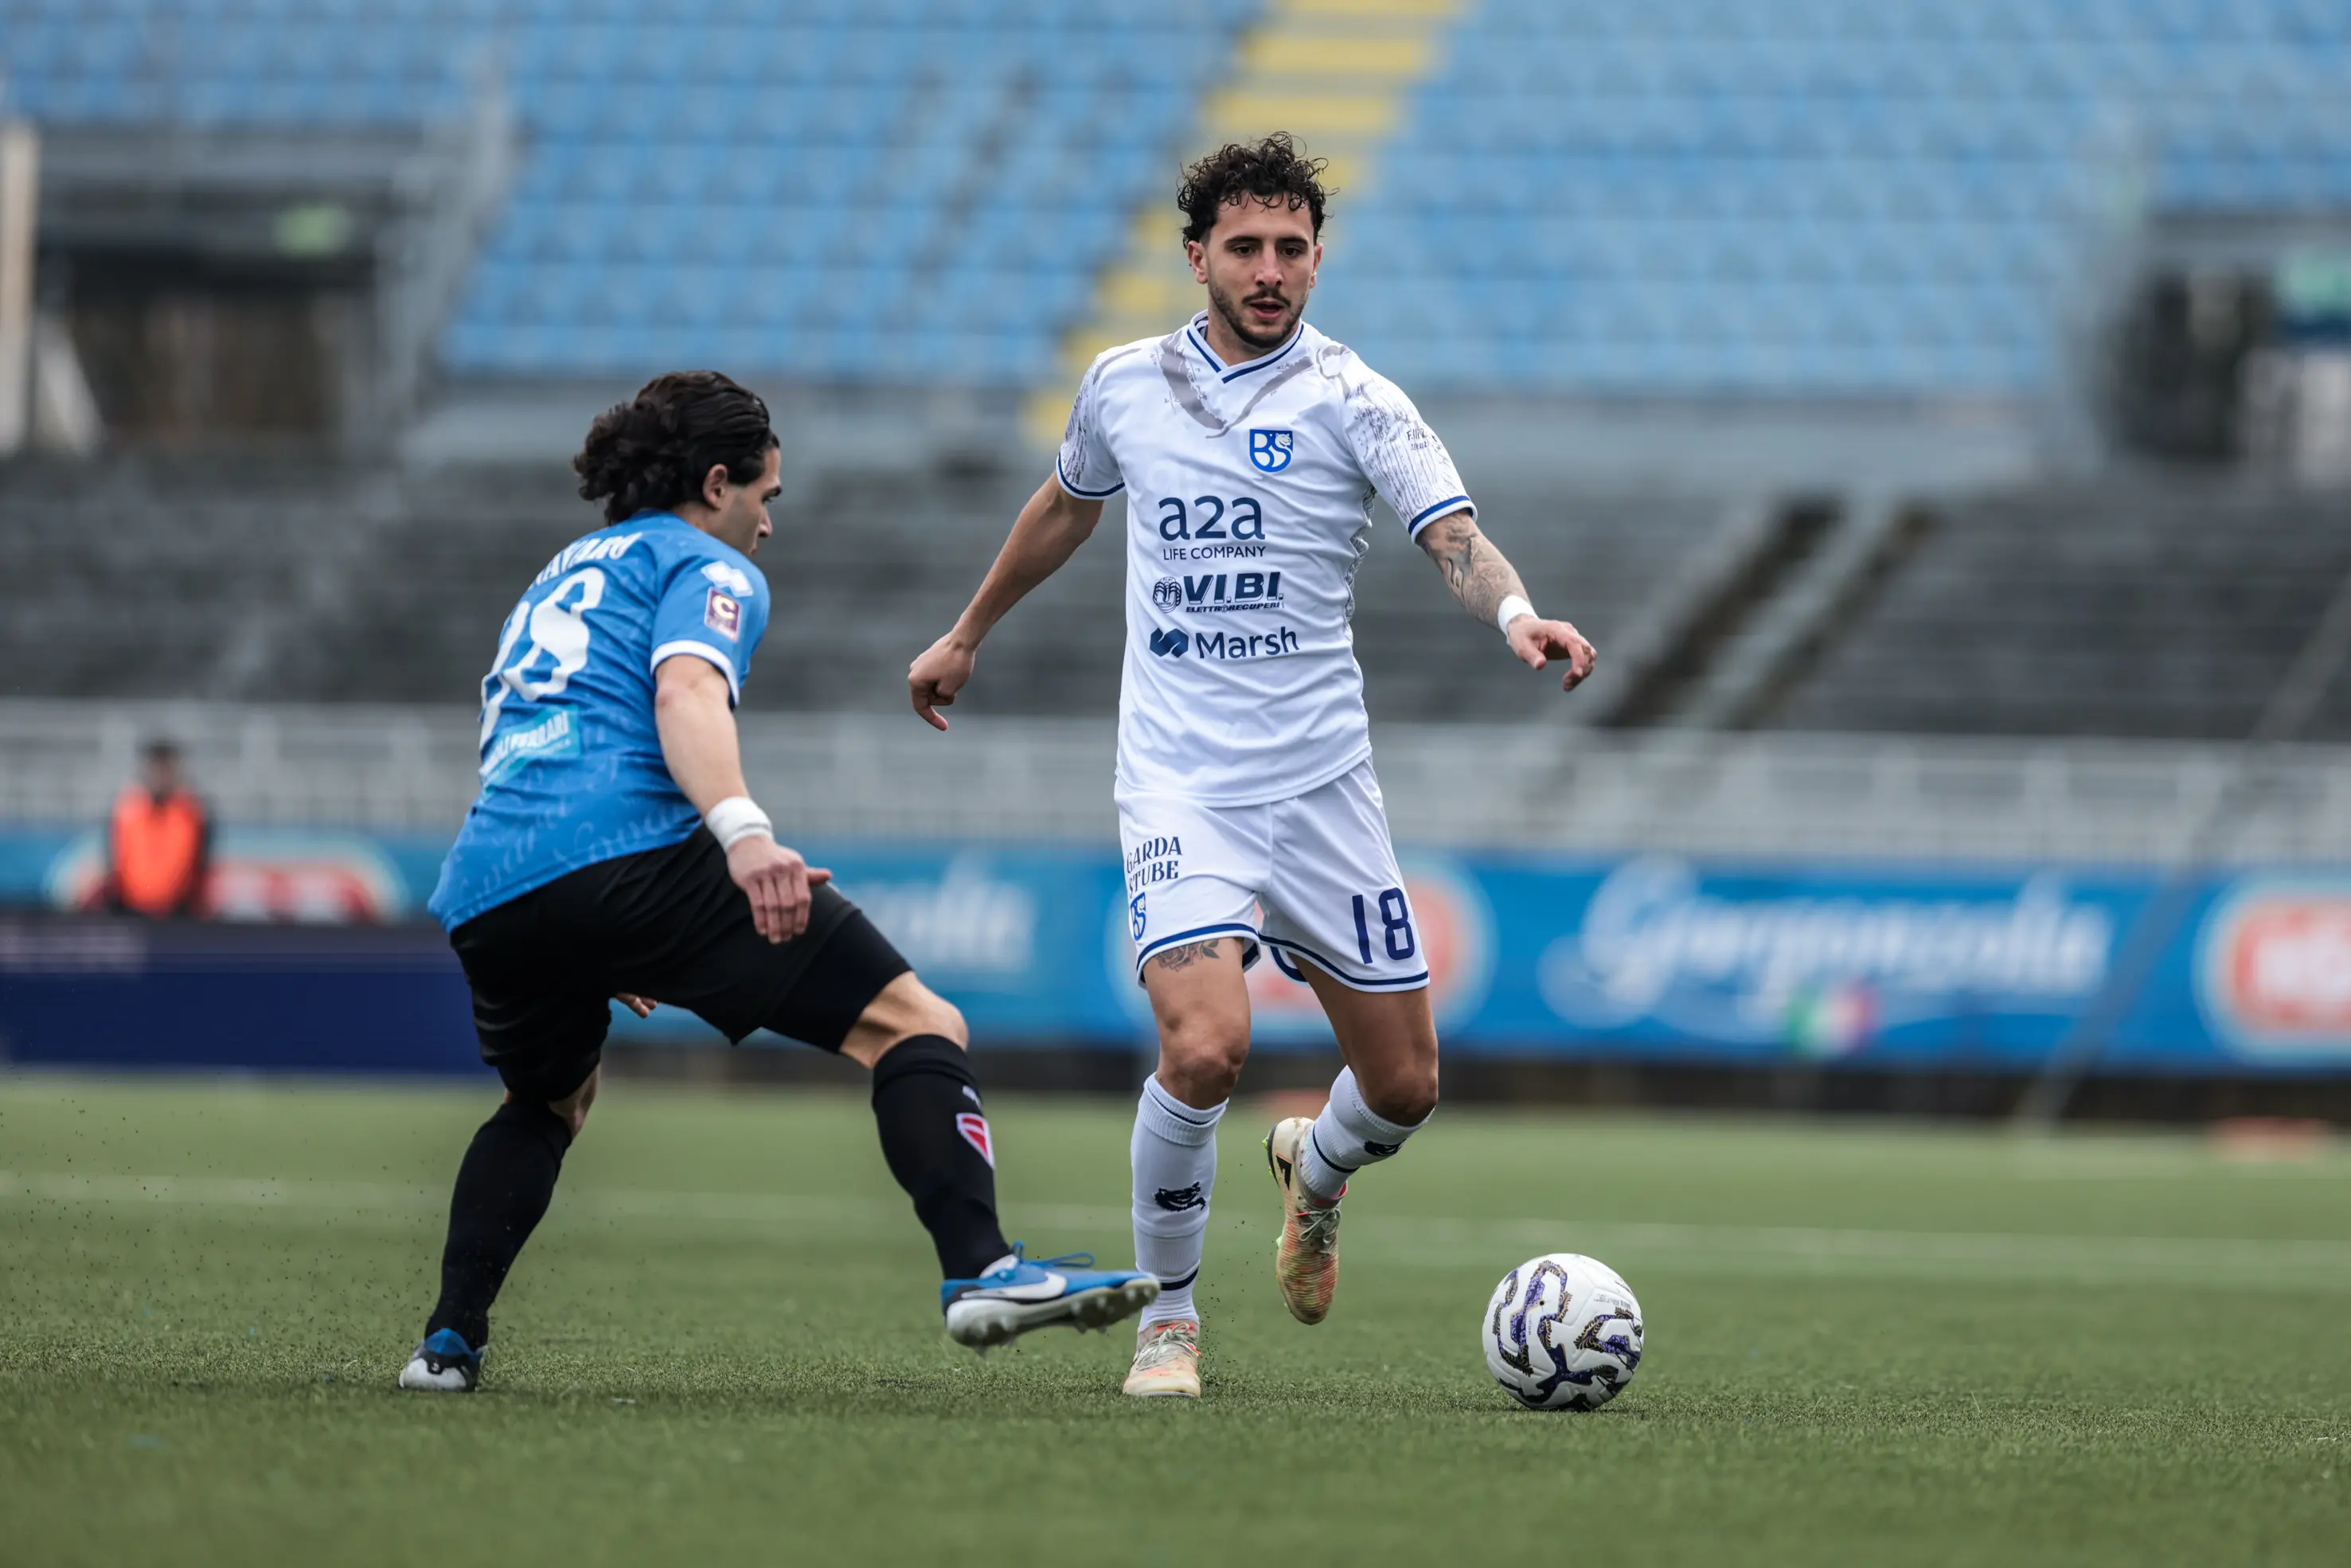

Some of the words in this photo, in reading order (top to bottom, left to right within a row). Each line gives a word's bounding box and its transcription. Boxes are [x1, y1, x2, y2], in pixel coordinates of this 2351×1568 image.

[1158, 495, 1265, 541] a2a
[1163, 548, 1187, 560] LIFE
[1191, 546, 1266, 560] COMPANY
[1195, 626, 1300, 659] Marsh
[1127, 837, 1182, 874] GARDA
[1129, 860, 1179, 899] STUBE
[1352, 887, 1416, 965] 18
